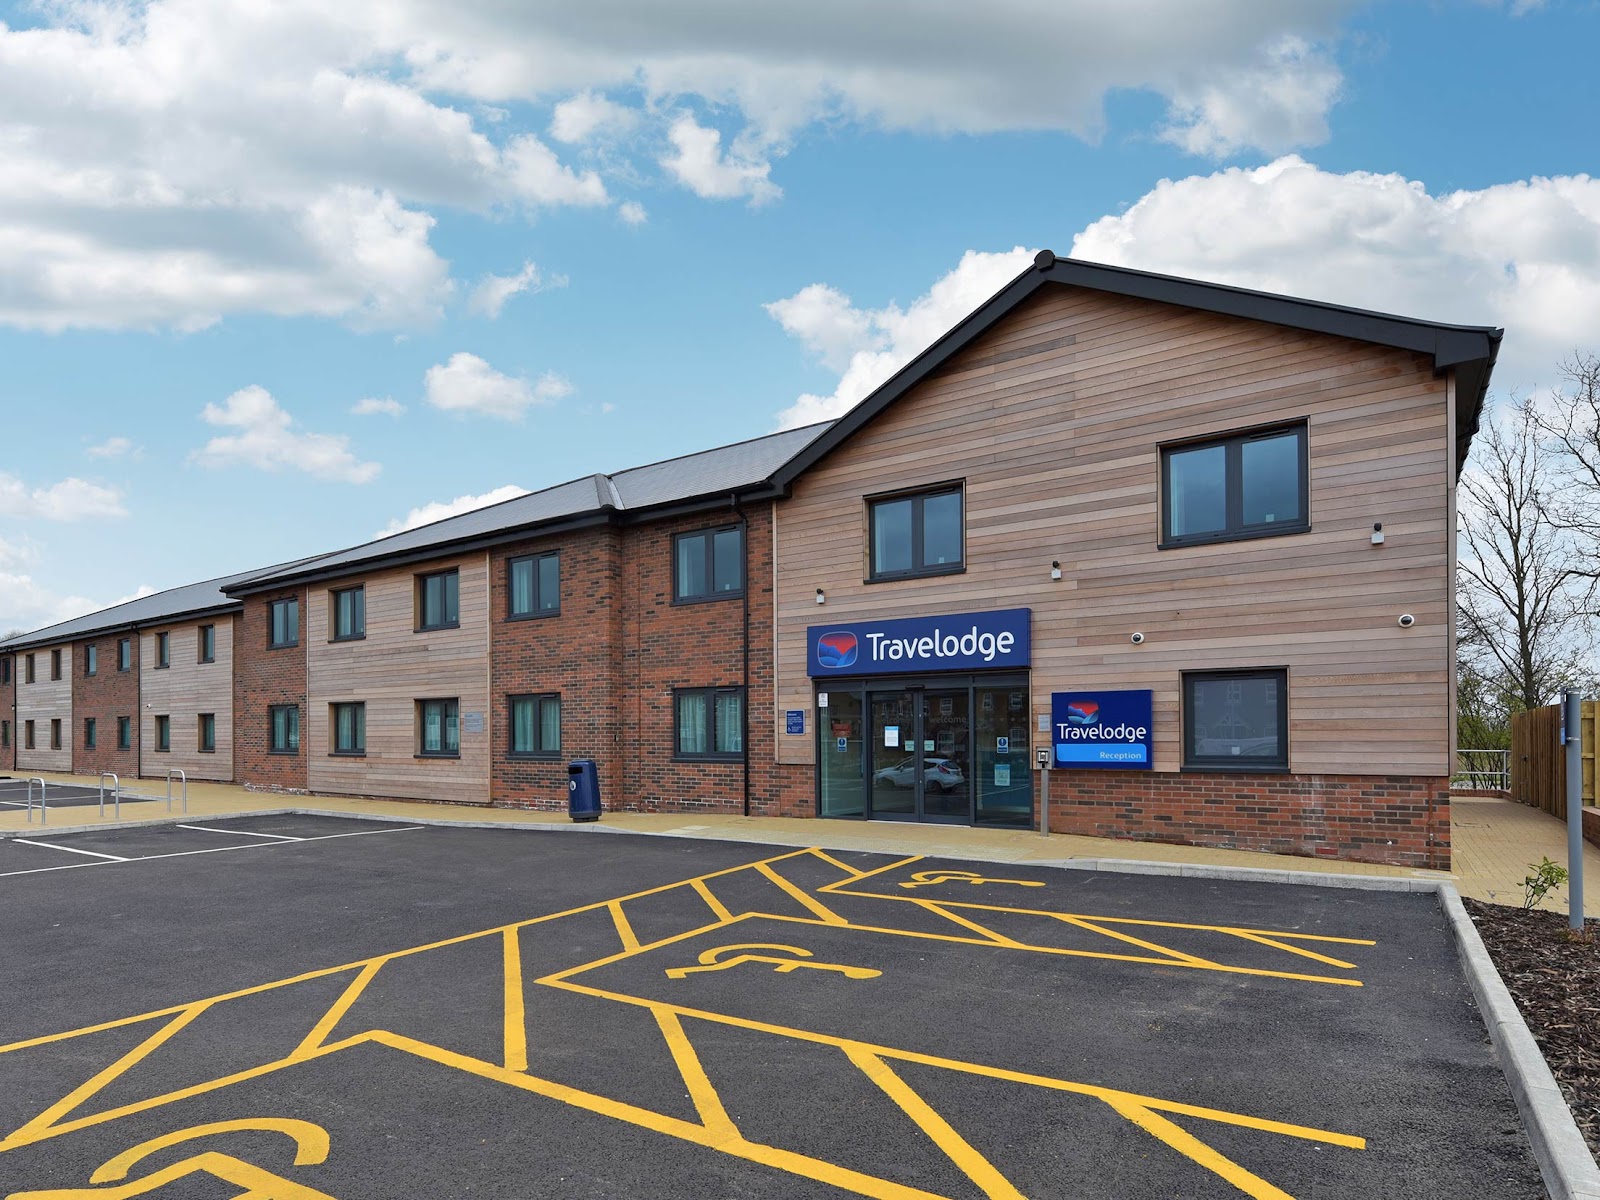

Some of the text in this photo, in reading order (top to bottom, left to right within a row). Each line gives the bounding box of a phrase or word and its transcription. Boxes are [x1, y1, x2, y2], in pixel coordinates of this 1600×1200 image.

[866, 625, 1015, 662] Travelodge
[1056, 723, 1147, 743] Travelodge
[1100, 751, 1142, 761] Reception
